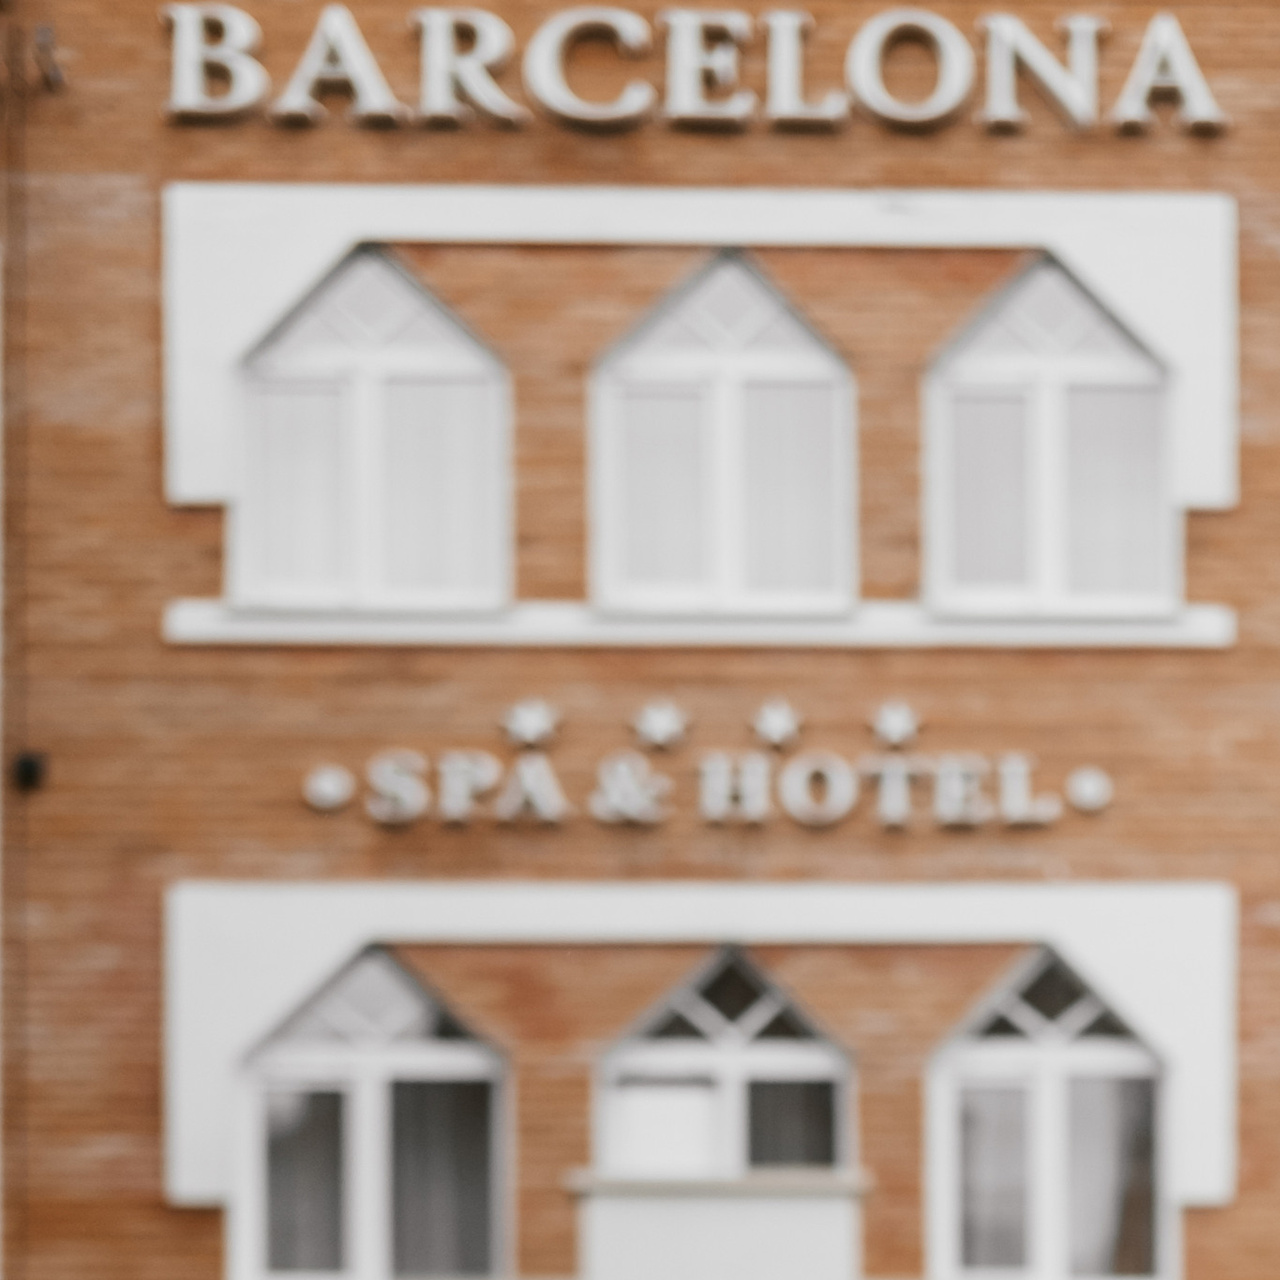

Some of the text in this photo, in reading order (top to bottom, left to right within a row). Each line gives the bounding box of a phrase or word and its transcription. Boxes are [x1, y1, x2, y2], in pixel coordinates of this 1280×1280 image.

[164, 2, 1226, 132] BARCELONA
[366, 747, 1062, 828] SPA & HOTEL
